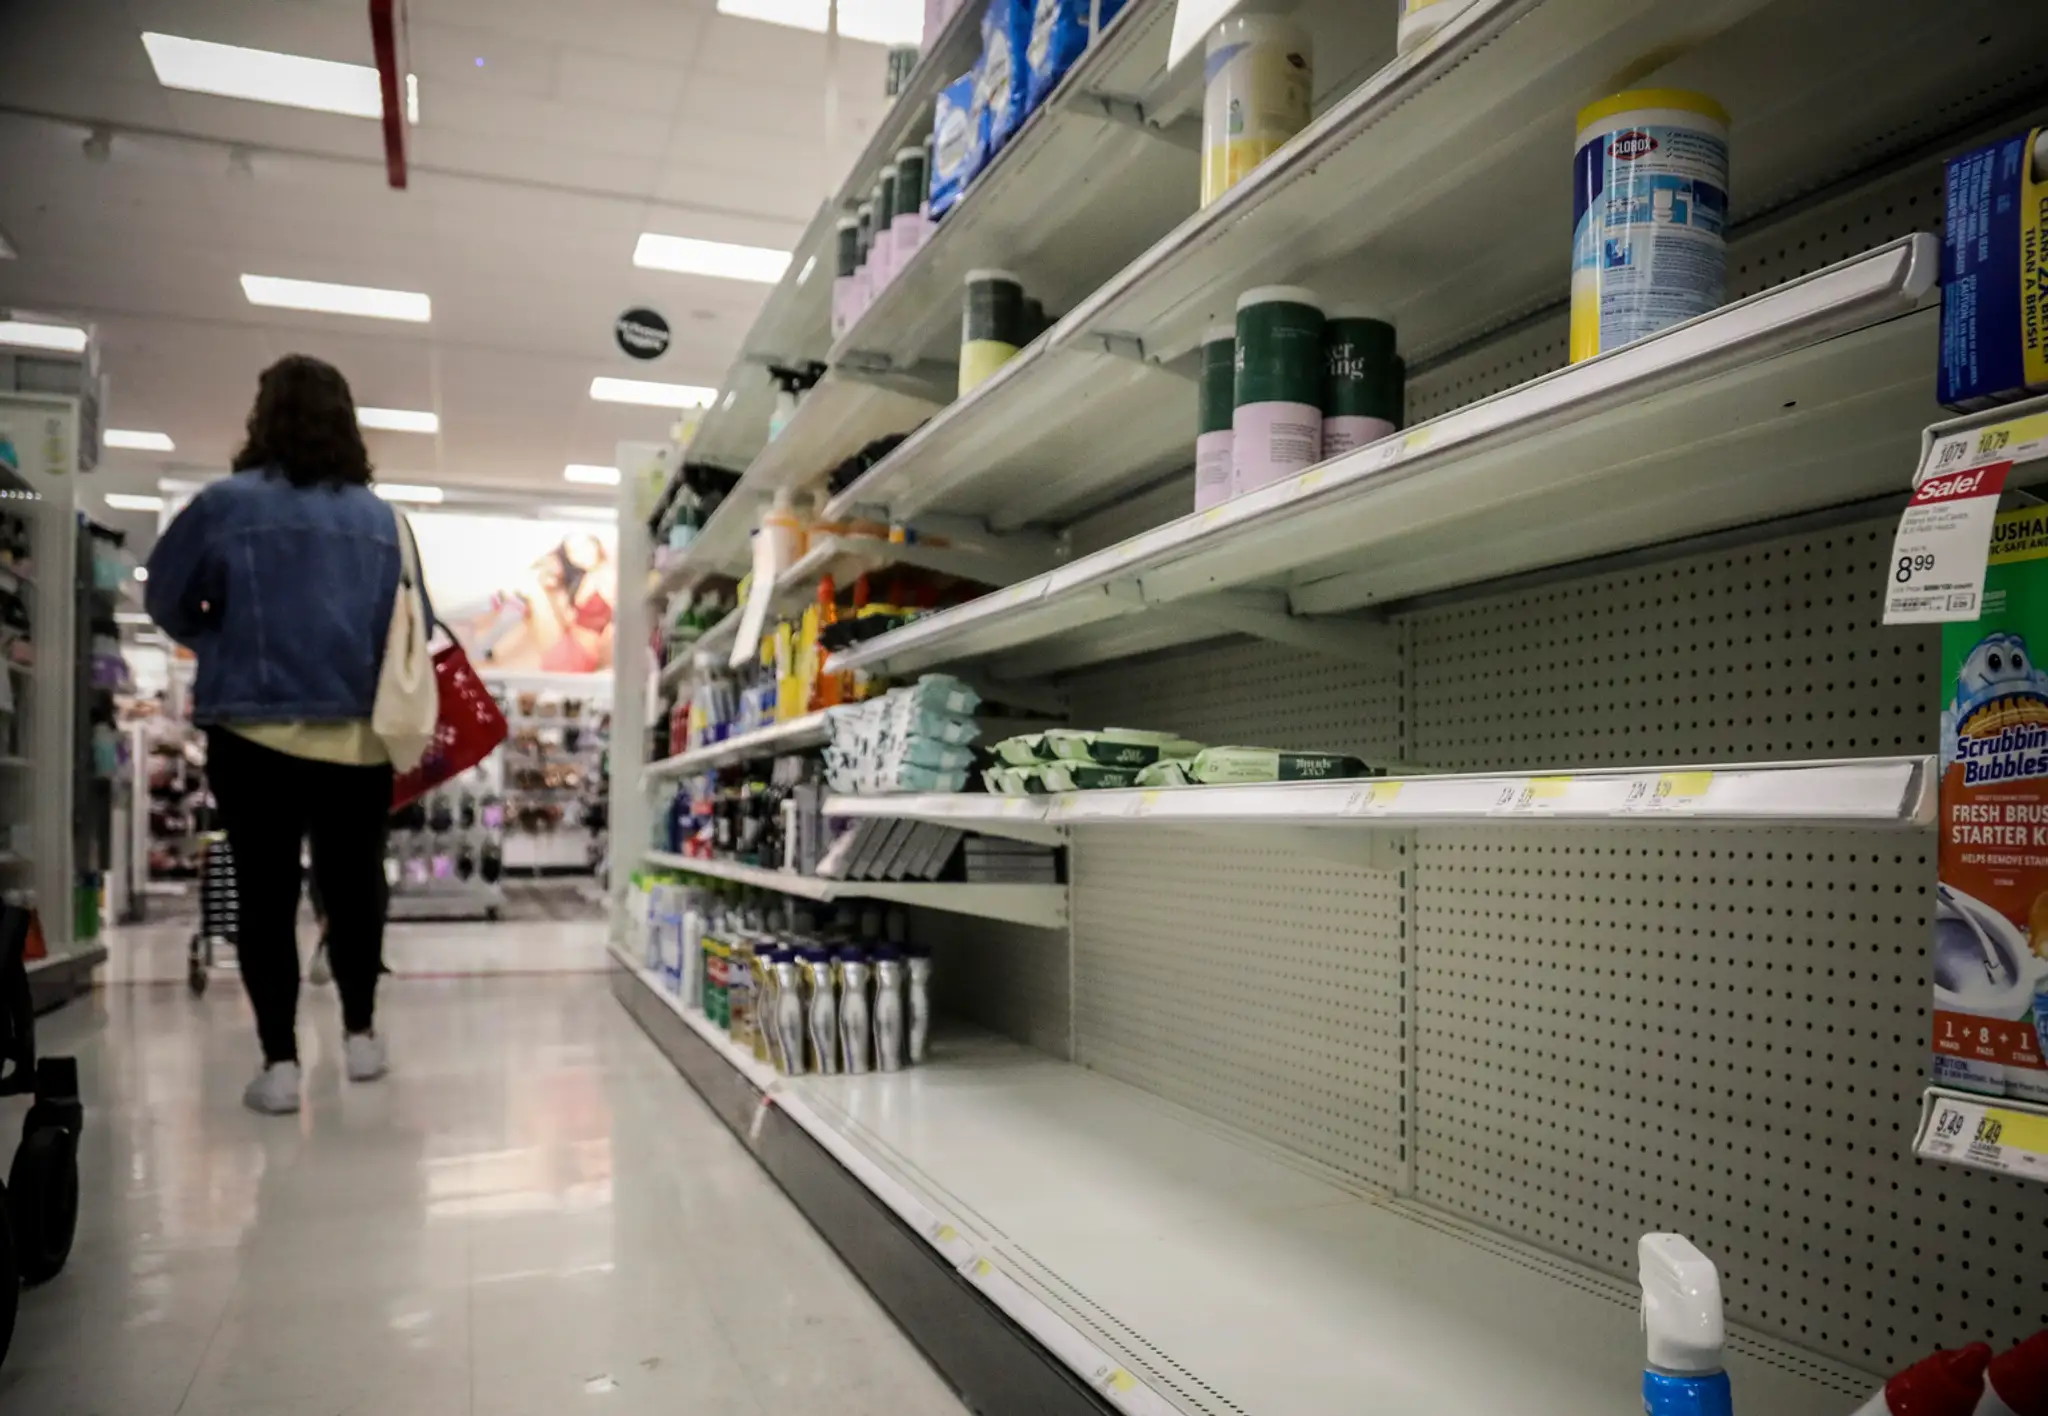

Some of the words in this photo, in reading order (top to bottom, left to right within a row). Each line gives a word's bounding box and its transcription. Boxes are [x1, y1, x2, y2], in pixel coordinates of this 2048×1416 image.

[1614, 138, 1651, 154] CLOROX
[2025, 227, 2037, 273] THAN
[2025, 278, 2037, 291] A
[2026, 293, 2038, 350] BRUSH
[1917, 470, 1986, 500] Sale!
[1990, 515, 2048, 543] USHA
[1956, 726, 2048, 760] Scrubbin
[1965, 752, 2048, 783] Bubbles
[1952, 804, 2001, 823] FRESH
[1951, 825, 2028, 846] STARTER
[1961, 854, 1986, 865] HELPS
[1986, 854, 2024, 867] REMOVE
[1945, 1020, 1954, 1038] 1
[1979, 1026, 1989, 1044] 8
[2020, 1032, 2030, 1050] 1
[1936, 1109, 1964, 1136] 9.49
[1974, 1117, 2002, 1145] 9.49
